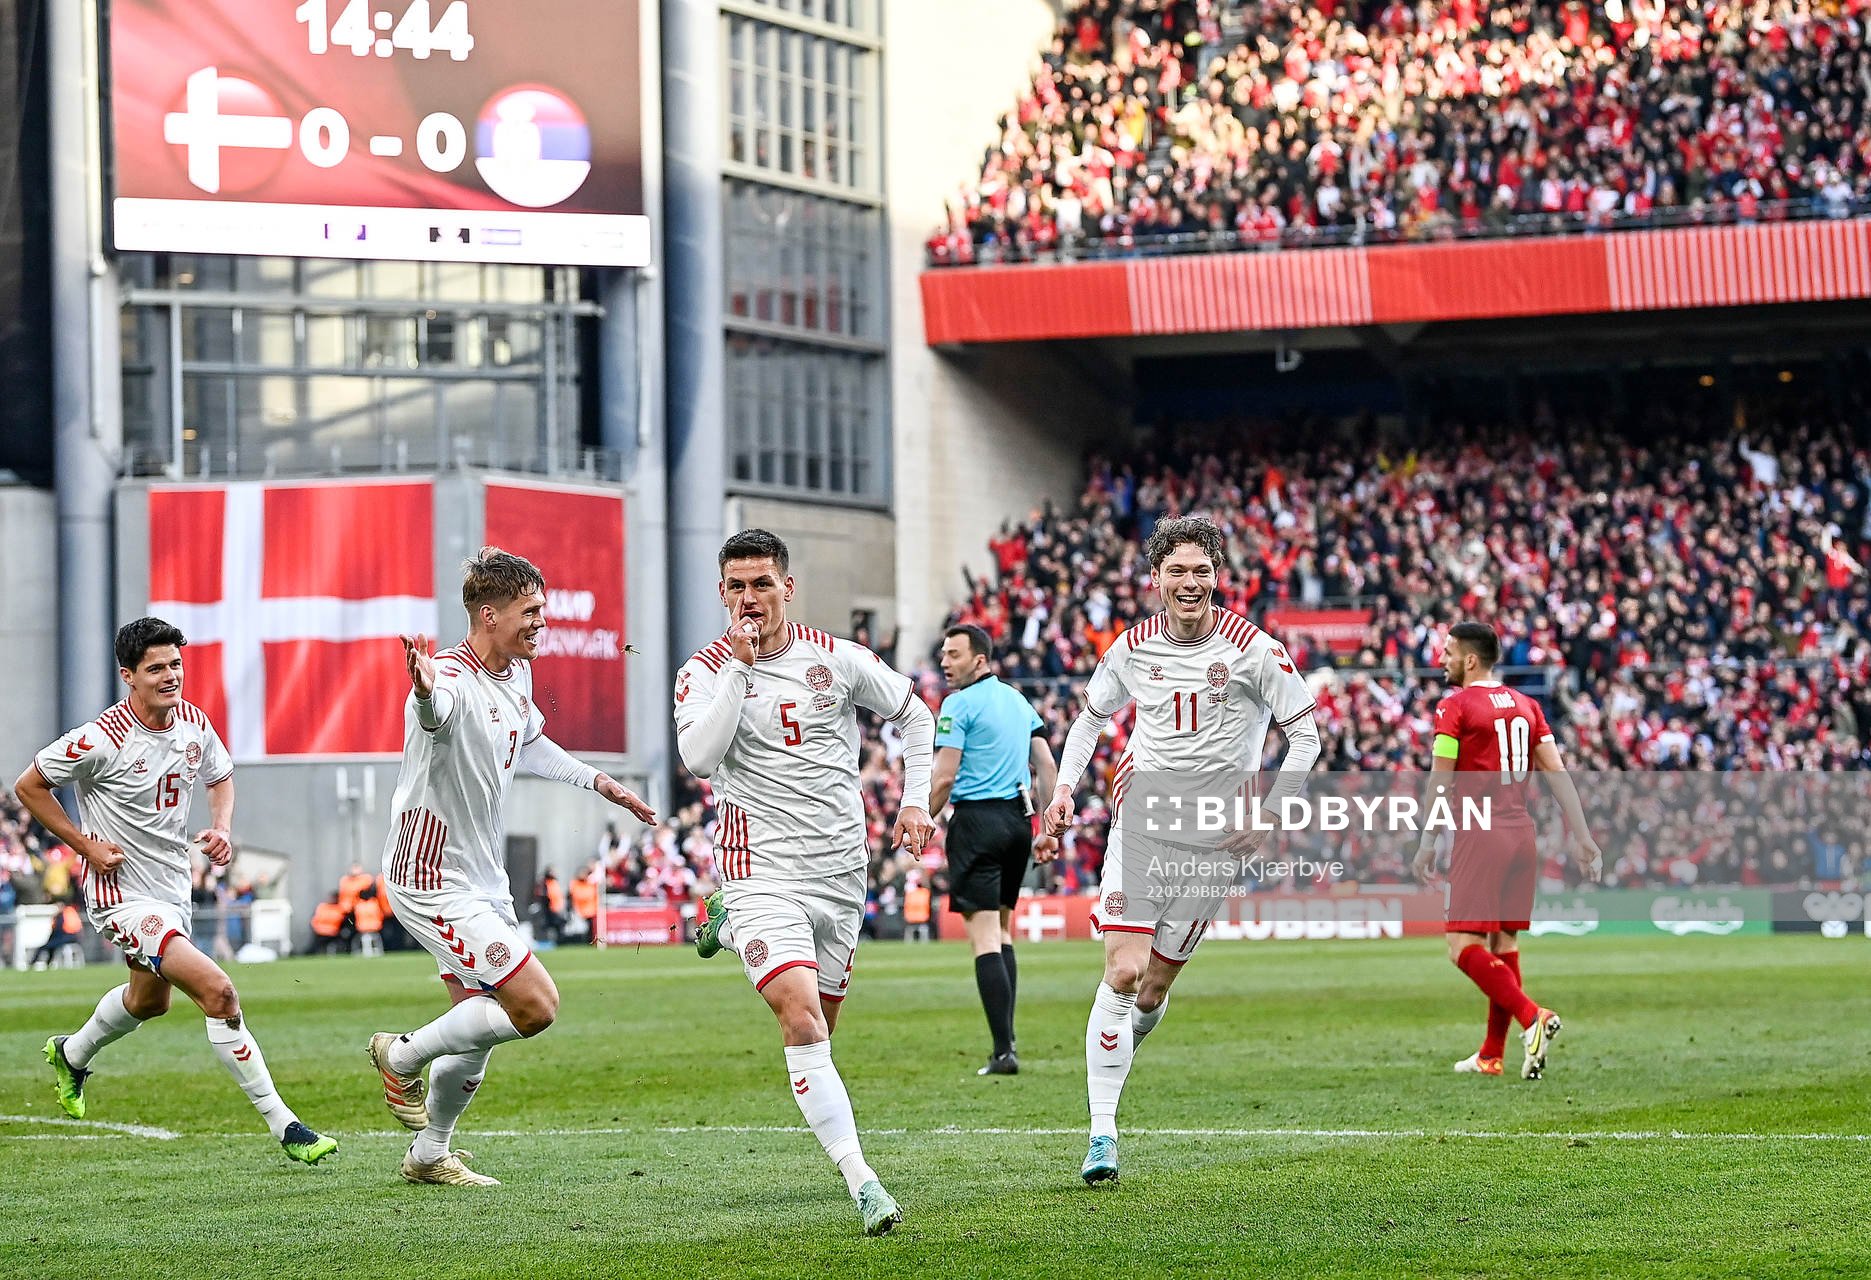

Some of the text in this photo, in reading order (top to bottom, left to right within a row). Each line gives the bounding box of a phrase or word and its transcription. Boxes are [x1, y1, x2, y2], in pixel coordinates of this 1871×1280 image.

[296, 0, 475, 61] 14:44
[299, 107, 350, 168] 0
[416, 112, 467, 173] 0
[780, 702, 801, 746] 5
[1173, 691, 1198, 731] 11
[504, 730, 517, 769] 3
[1494, 716, 1530, 785] 10
[155, 773, 181, 811] 15
